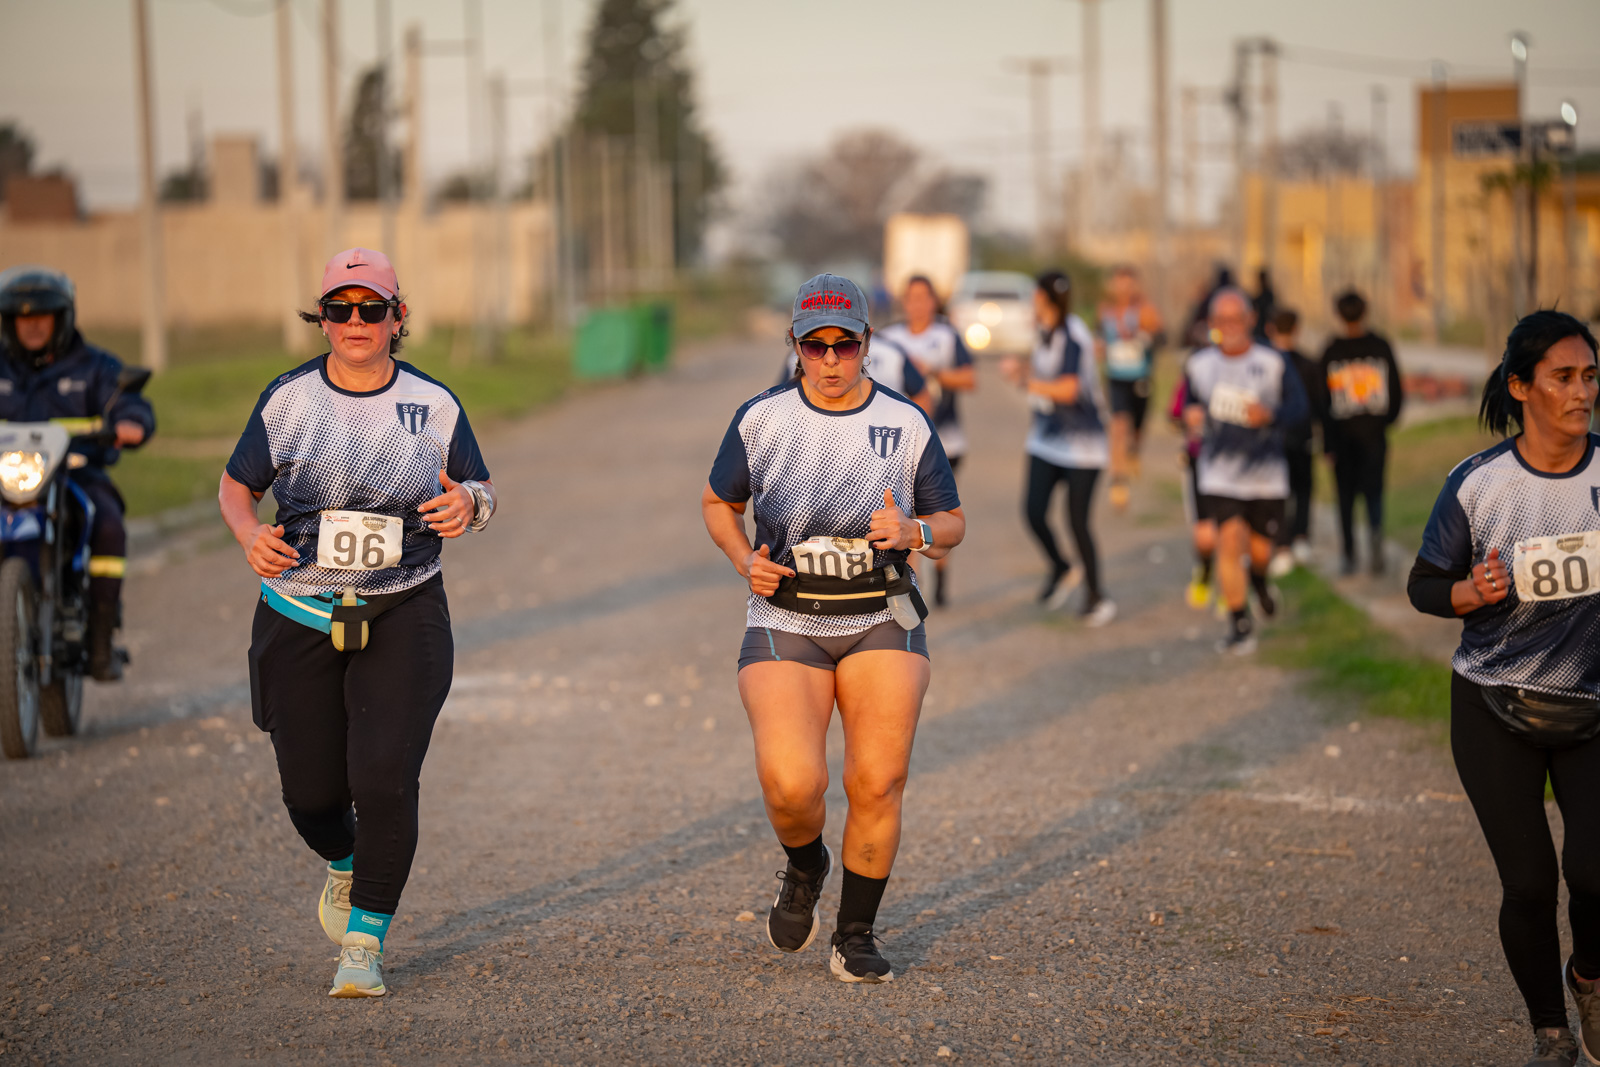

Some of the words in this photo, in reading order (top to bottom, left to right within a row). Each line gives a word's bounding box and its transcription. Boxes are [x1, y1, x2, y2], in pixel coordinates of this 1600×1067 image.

[801, 295, 852, 310] CHAMPS
[402, 405, 423, 414] SFC
[874, 428, 896, 437] SFC
[333, 531, 385, 568] 96
[799, 551, 868, 579] 108
[1531, 555, 1590, 597] 80
